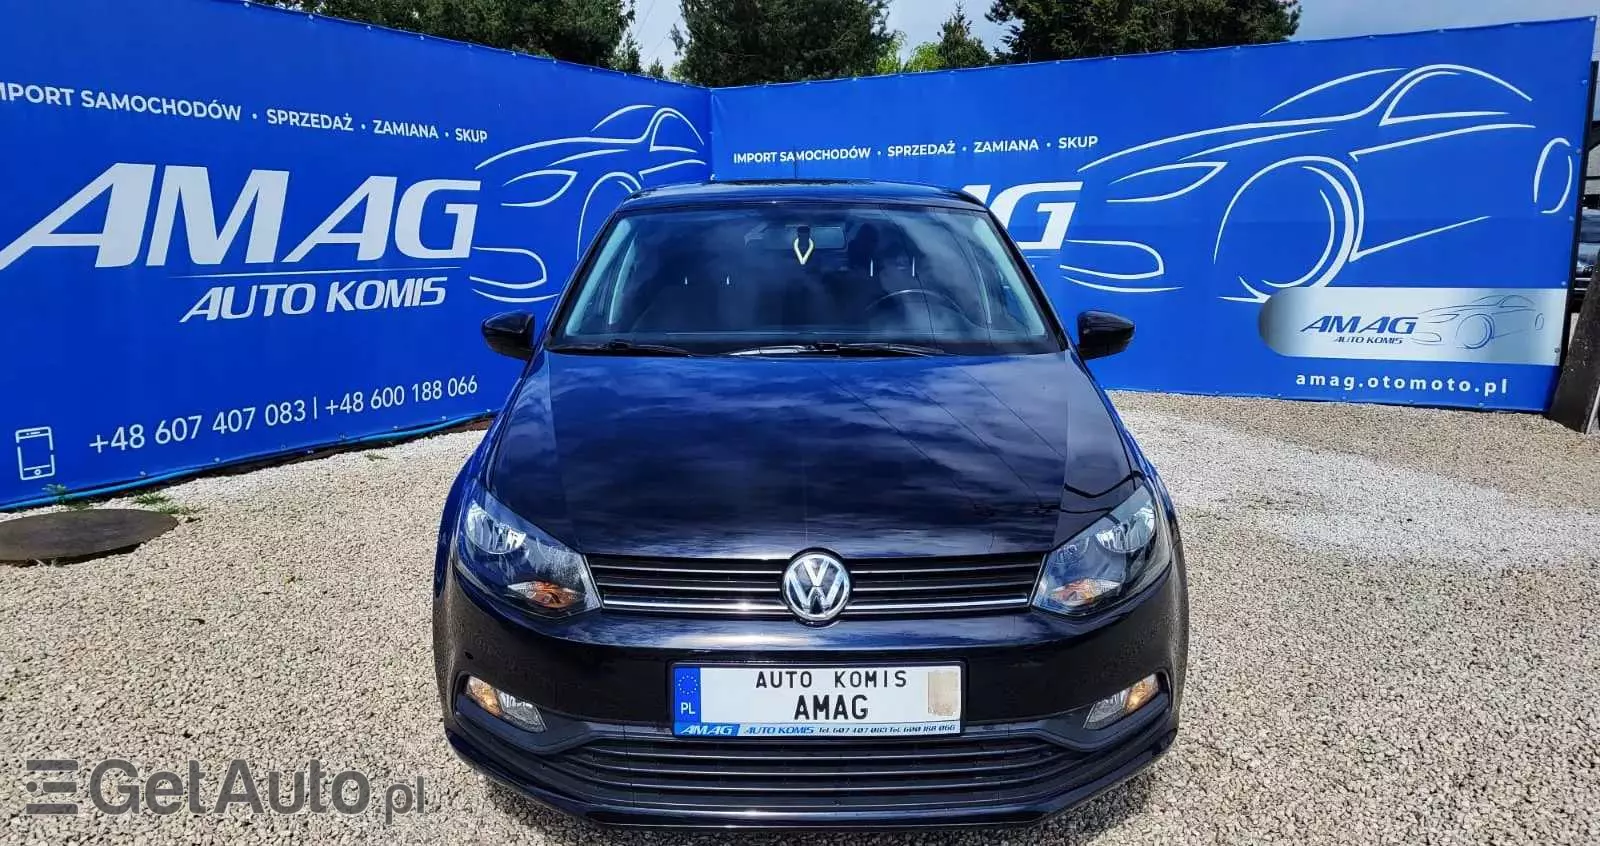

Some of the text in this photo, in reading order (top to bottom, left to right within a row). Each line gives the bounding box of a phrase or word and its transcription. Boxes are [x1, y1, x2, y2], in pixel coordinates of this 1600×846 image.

[81, 90, 241, 121] SAMOCHODÓW
[266, 109, 354, 132] SPRZEDAŻ
[373, 119, 439, 139] ZAMIANA
[455, 127, 488, 143] SKUP
[733, 135, 1098, 163] IMPORT SAMOCHODÓW SPRZEDAŻ ZAMIANA SKUP
[0, 162, 481, 270] AMAG
[180, 276, 448, 323] AUTO KOMIS
[1300, 315, 1419, 335] AMAG
[1366, 336, 1403, 344] KOMIS
[1295, 372, 1508, 395] amag.otomoto.pl
[89, 375, 478, 453] +48 607 407 083 +48 600 188 066
[755, 670, 908, 689] AUTO KOMIS
[680, 702, 696, 715] PL
[793, 694, 869, 720] AMAG
[680, 725, 735, 736] AMAG
[777, 726, 814, 734] KOMIS
